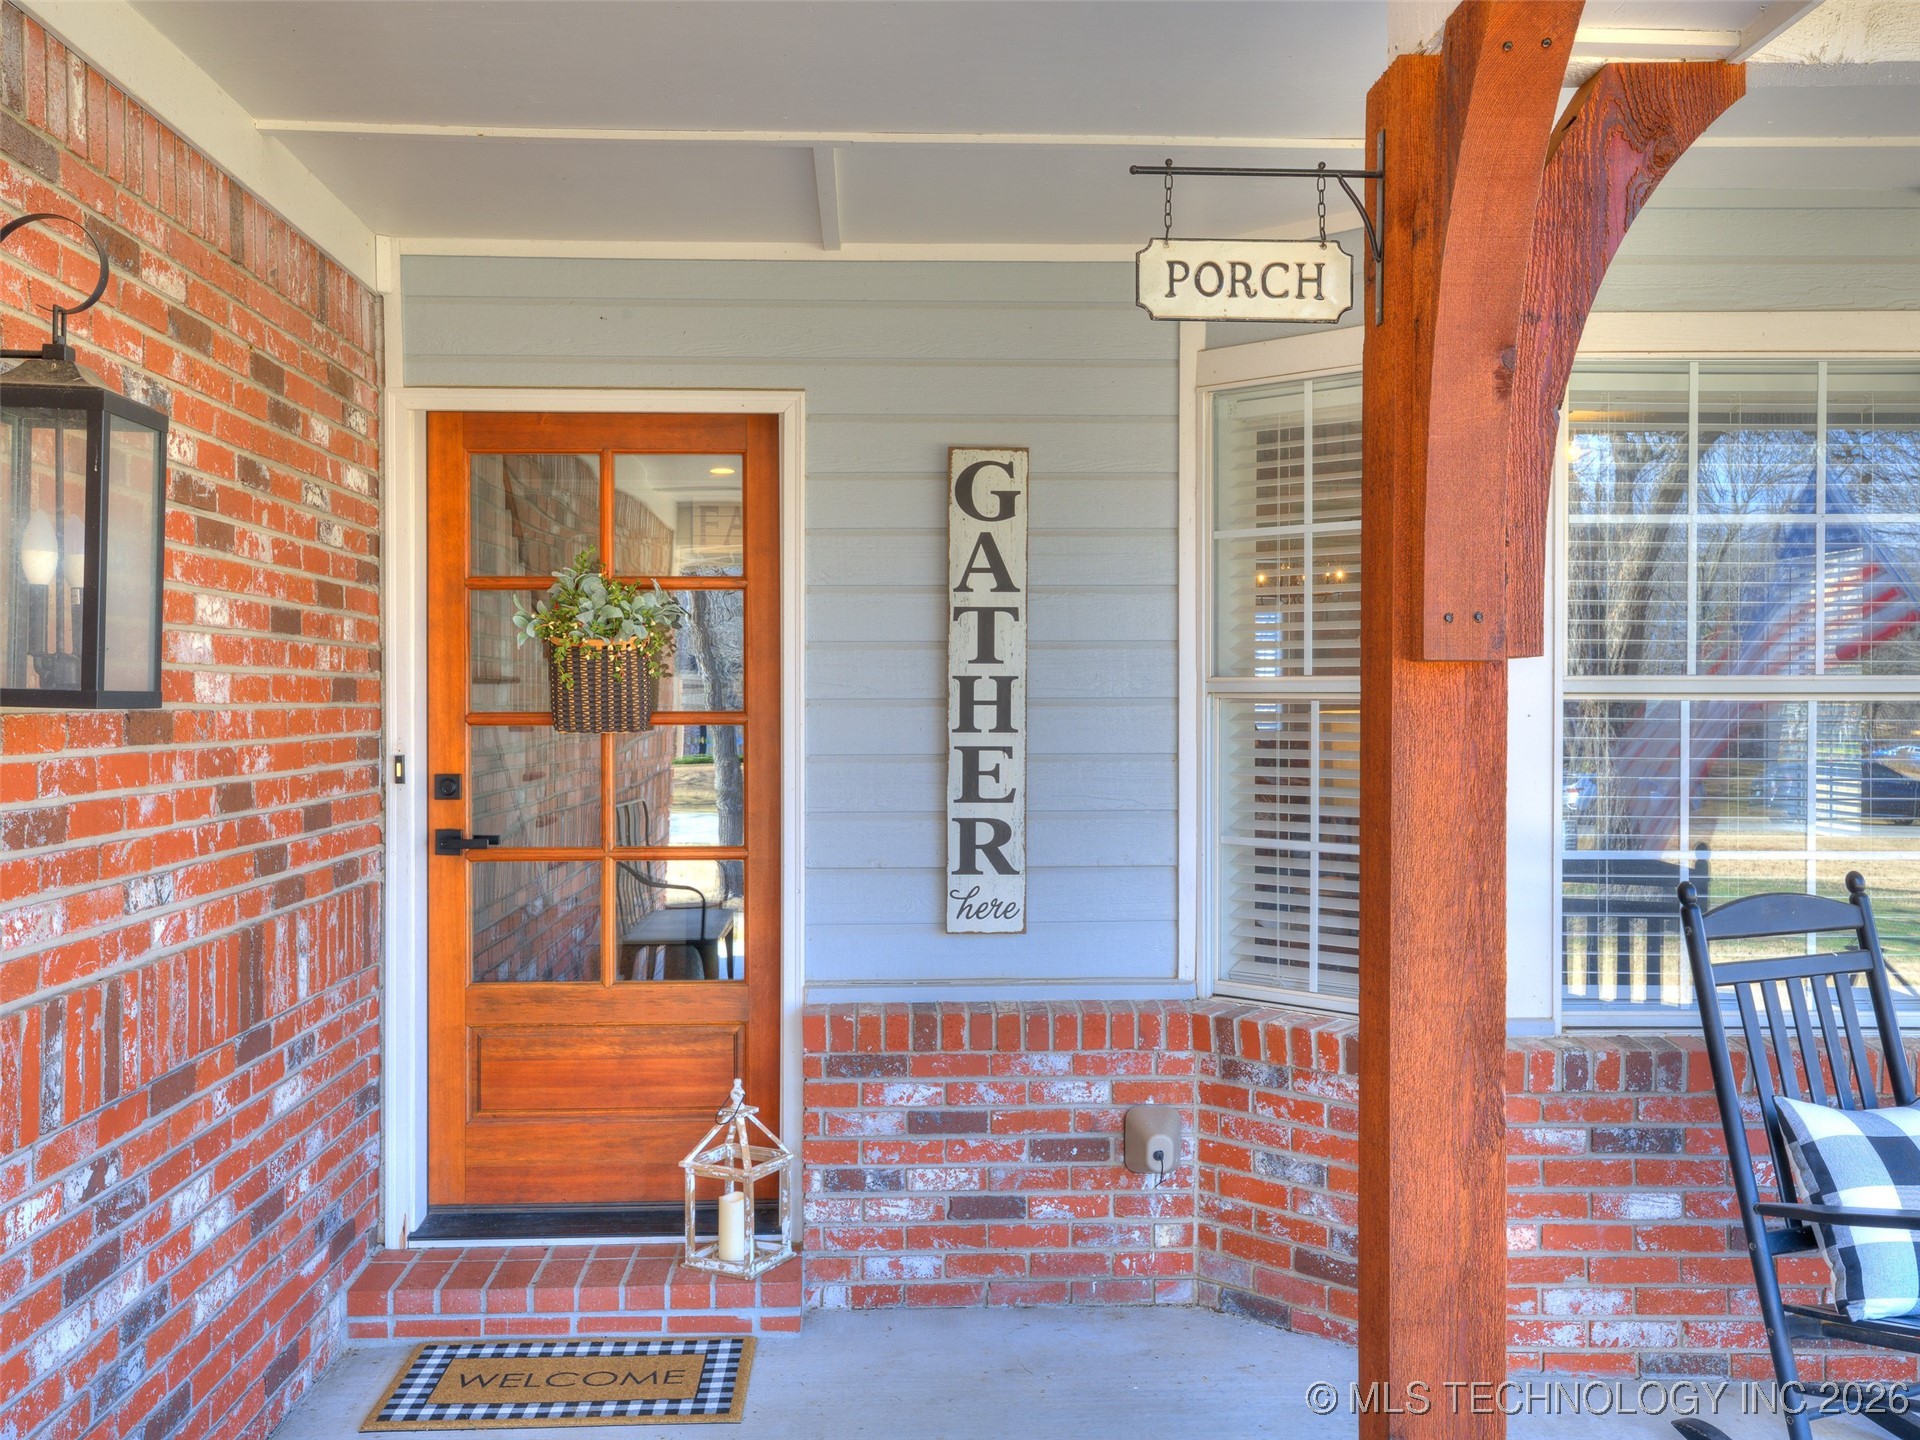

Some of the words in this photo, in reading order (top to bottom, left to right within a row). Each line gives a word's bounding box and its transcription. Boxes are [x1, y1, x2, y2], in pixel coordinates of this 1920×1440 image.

[1165, 260, 1326, 301] PORCH
[951, 460, 1022, 876] GATHER
[949, 885, 1021, 920] here
[459, 1369, 687, 1389] WELCOME
